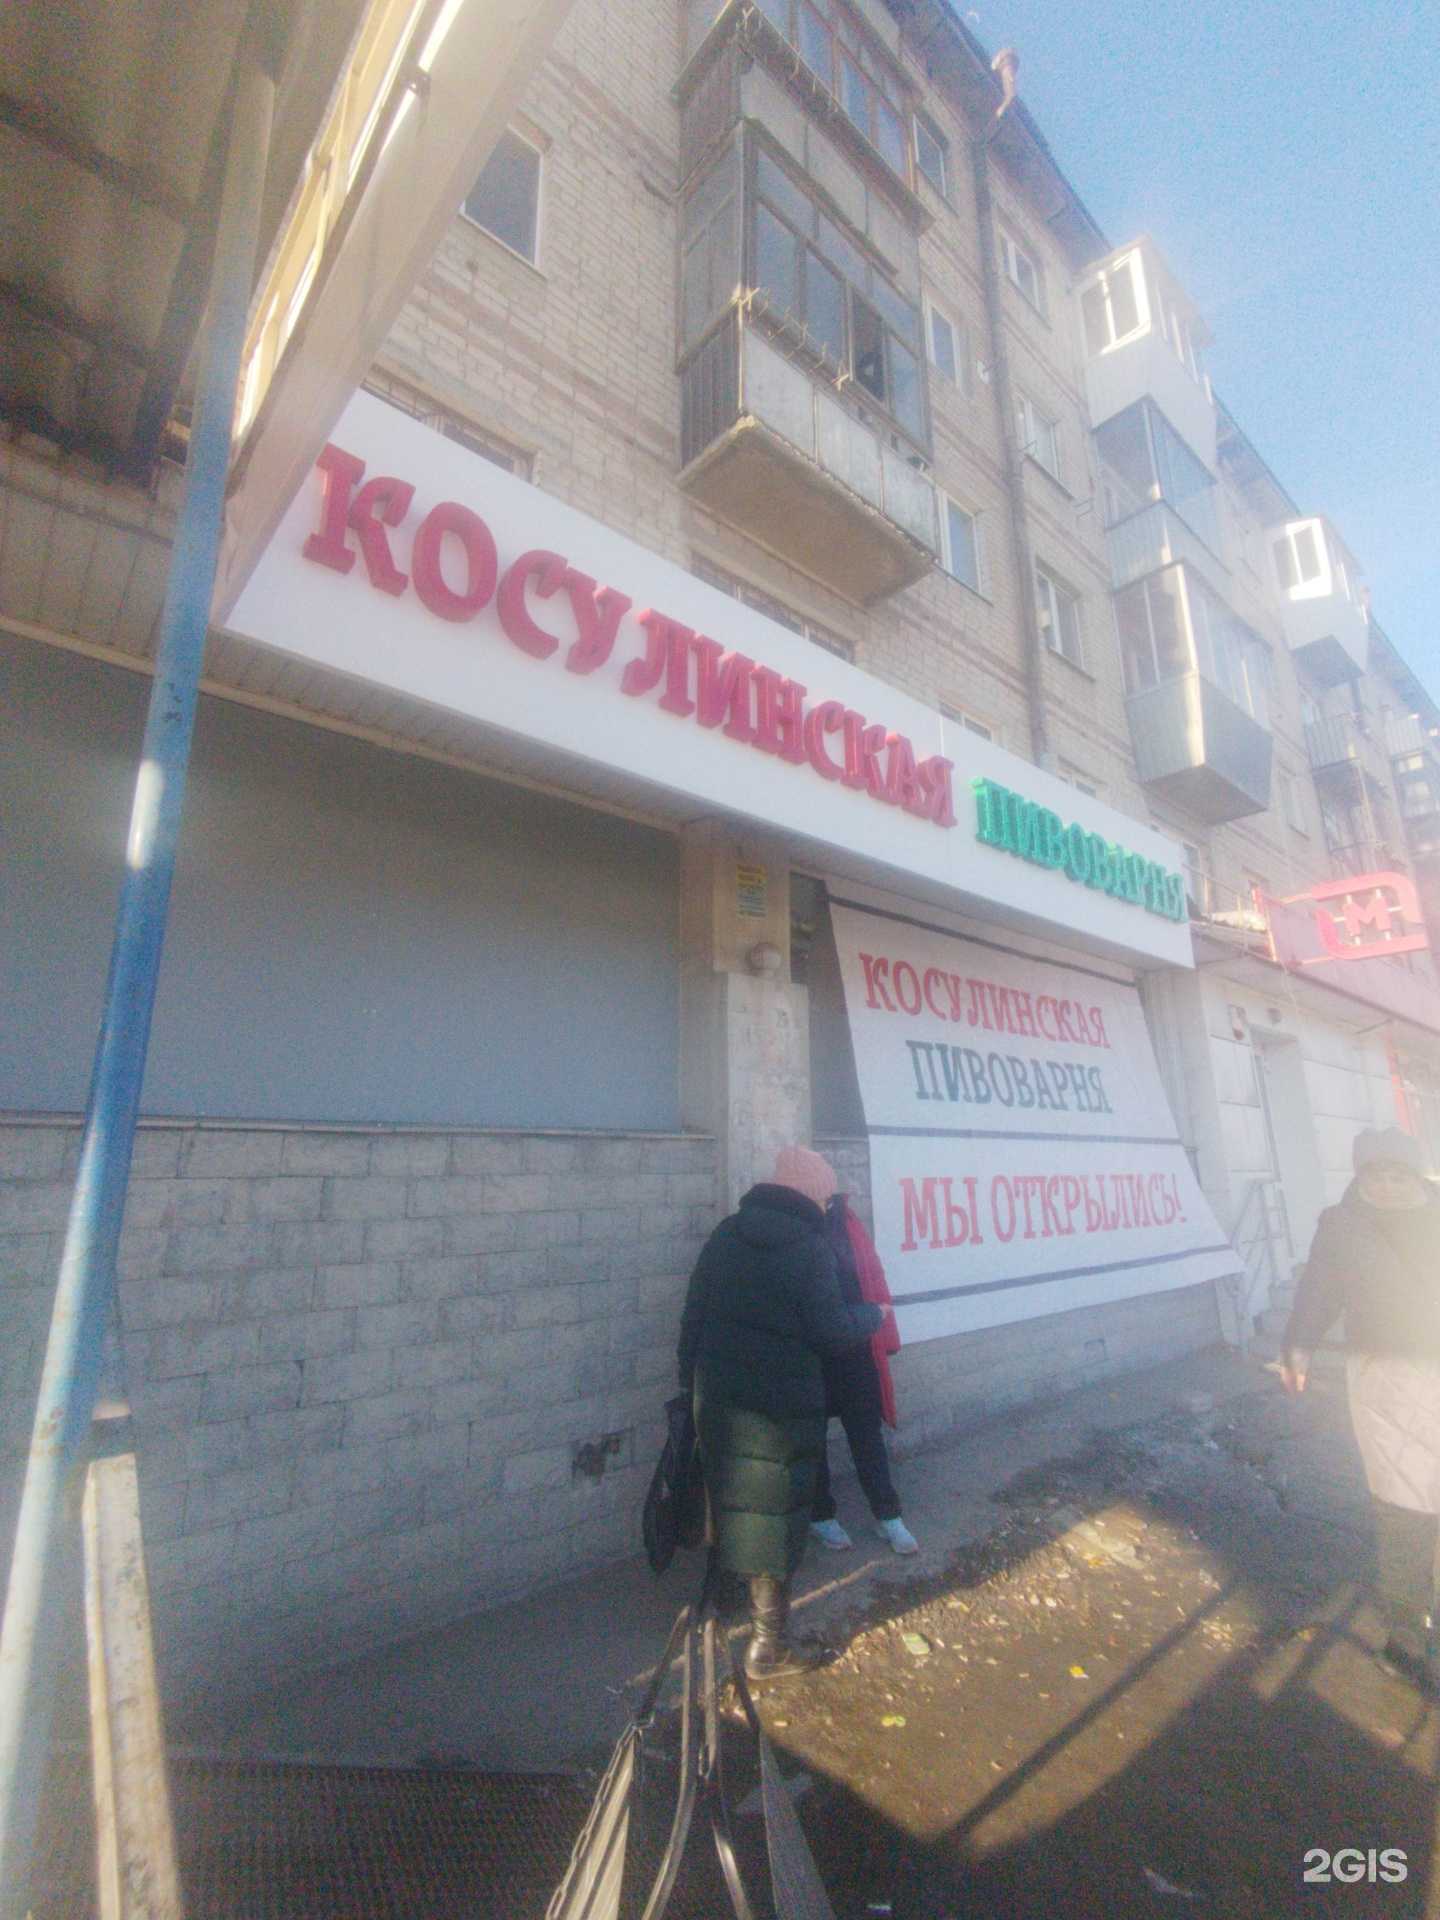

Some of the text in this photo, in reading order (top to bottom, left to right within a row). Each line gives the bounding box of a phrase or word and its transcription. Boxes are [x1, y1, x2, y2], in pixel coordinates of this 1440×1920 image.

[302, 442, 1188, 922] КОСУЛИНСКАЯ ПИВОВАРНЯ
[859, 953, 1111, 1048] КОСУЛИНСКАЯ
[905, 1040, 1113, 1114] ПИВОВАРНЯ
[901, 1173, 1187, 1251] МЫ ОТКРЫЛИСЬ!
